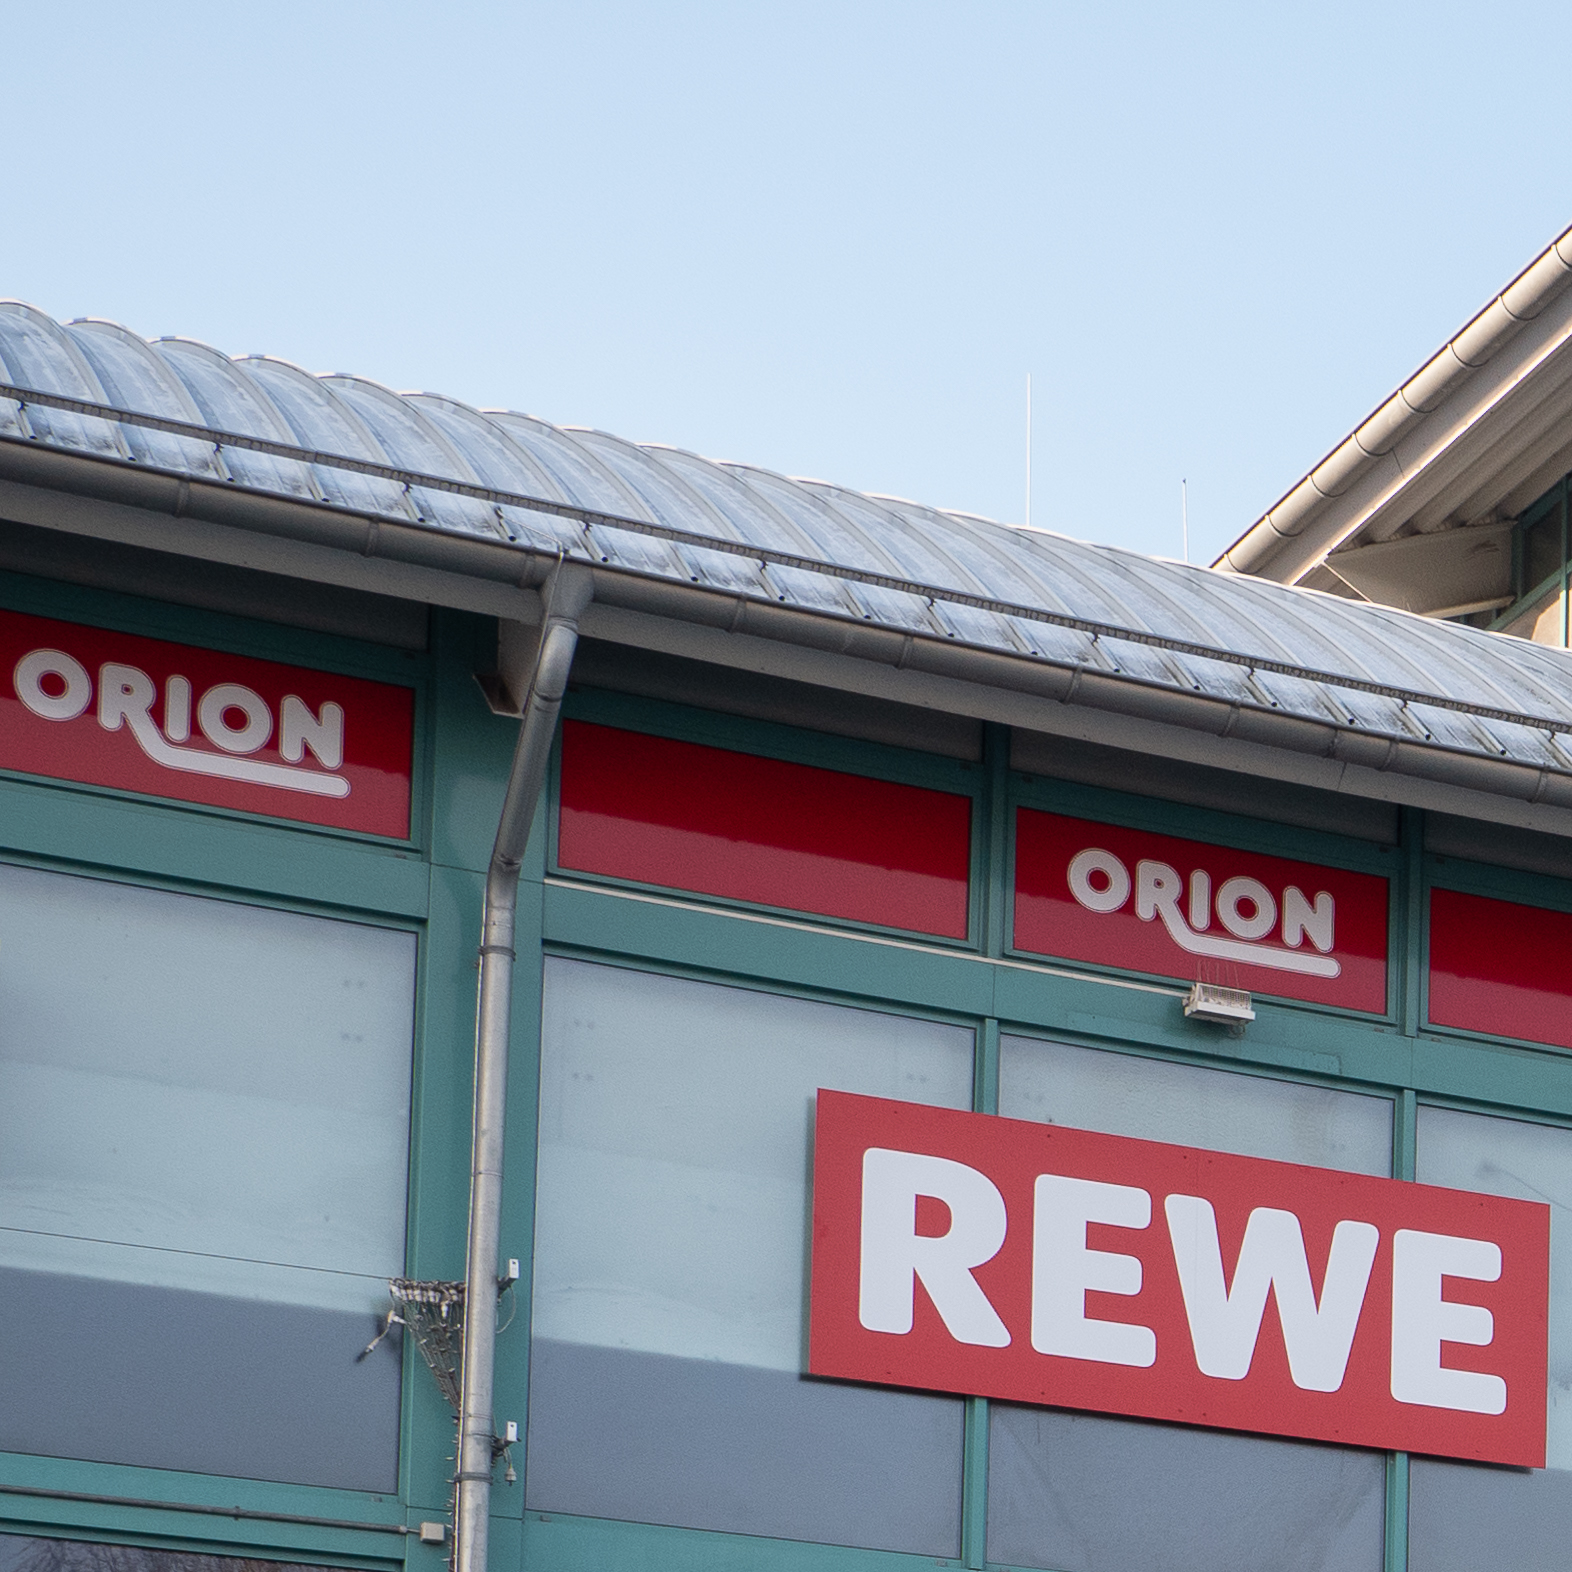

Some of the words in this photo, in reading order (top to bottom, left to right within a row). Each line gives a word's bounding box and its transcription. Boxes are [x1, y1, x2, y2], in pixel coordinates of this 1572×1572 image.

[13, 647, 352, 799] ORION
[1066, 847, 1342, 979] ORION
[858, 1145, 1508, 1416] REWE
